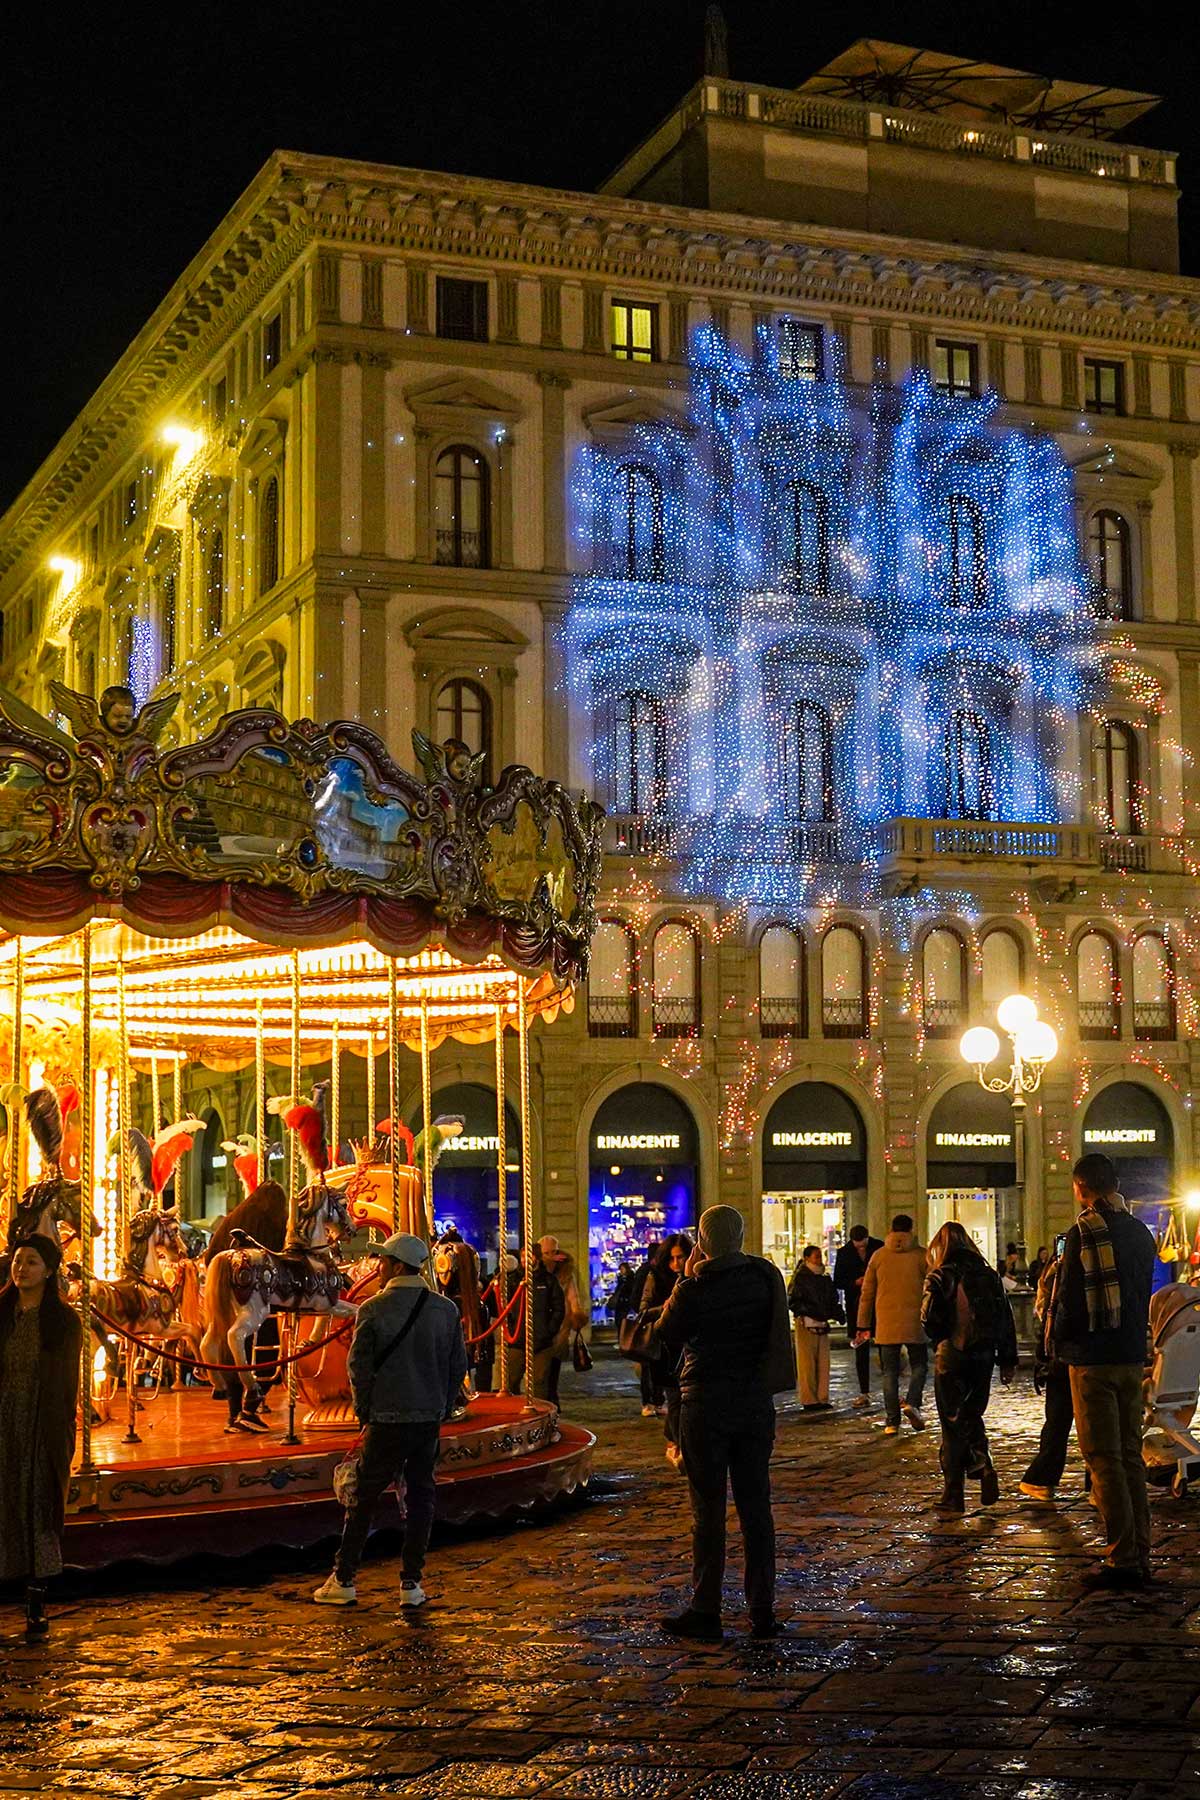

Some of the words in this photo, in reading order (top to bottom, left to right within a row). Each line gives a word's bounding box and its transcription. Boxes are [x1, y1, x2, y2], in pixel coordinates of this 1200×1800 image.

[597, 1135, 680, 1149] RINASCENTE
[772, 1132, 852, 1146] RINASCENTE
[935, 1133, 1011, 1146] RINASCENTE
[1084, 1129, 1156, 1142] RINASCENTE
[441, 1136, 501, 1150] ASCENT
